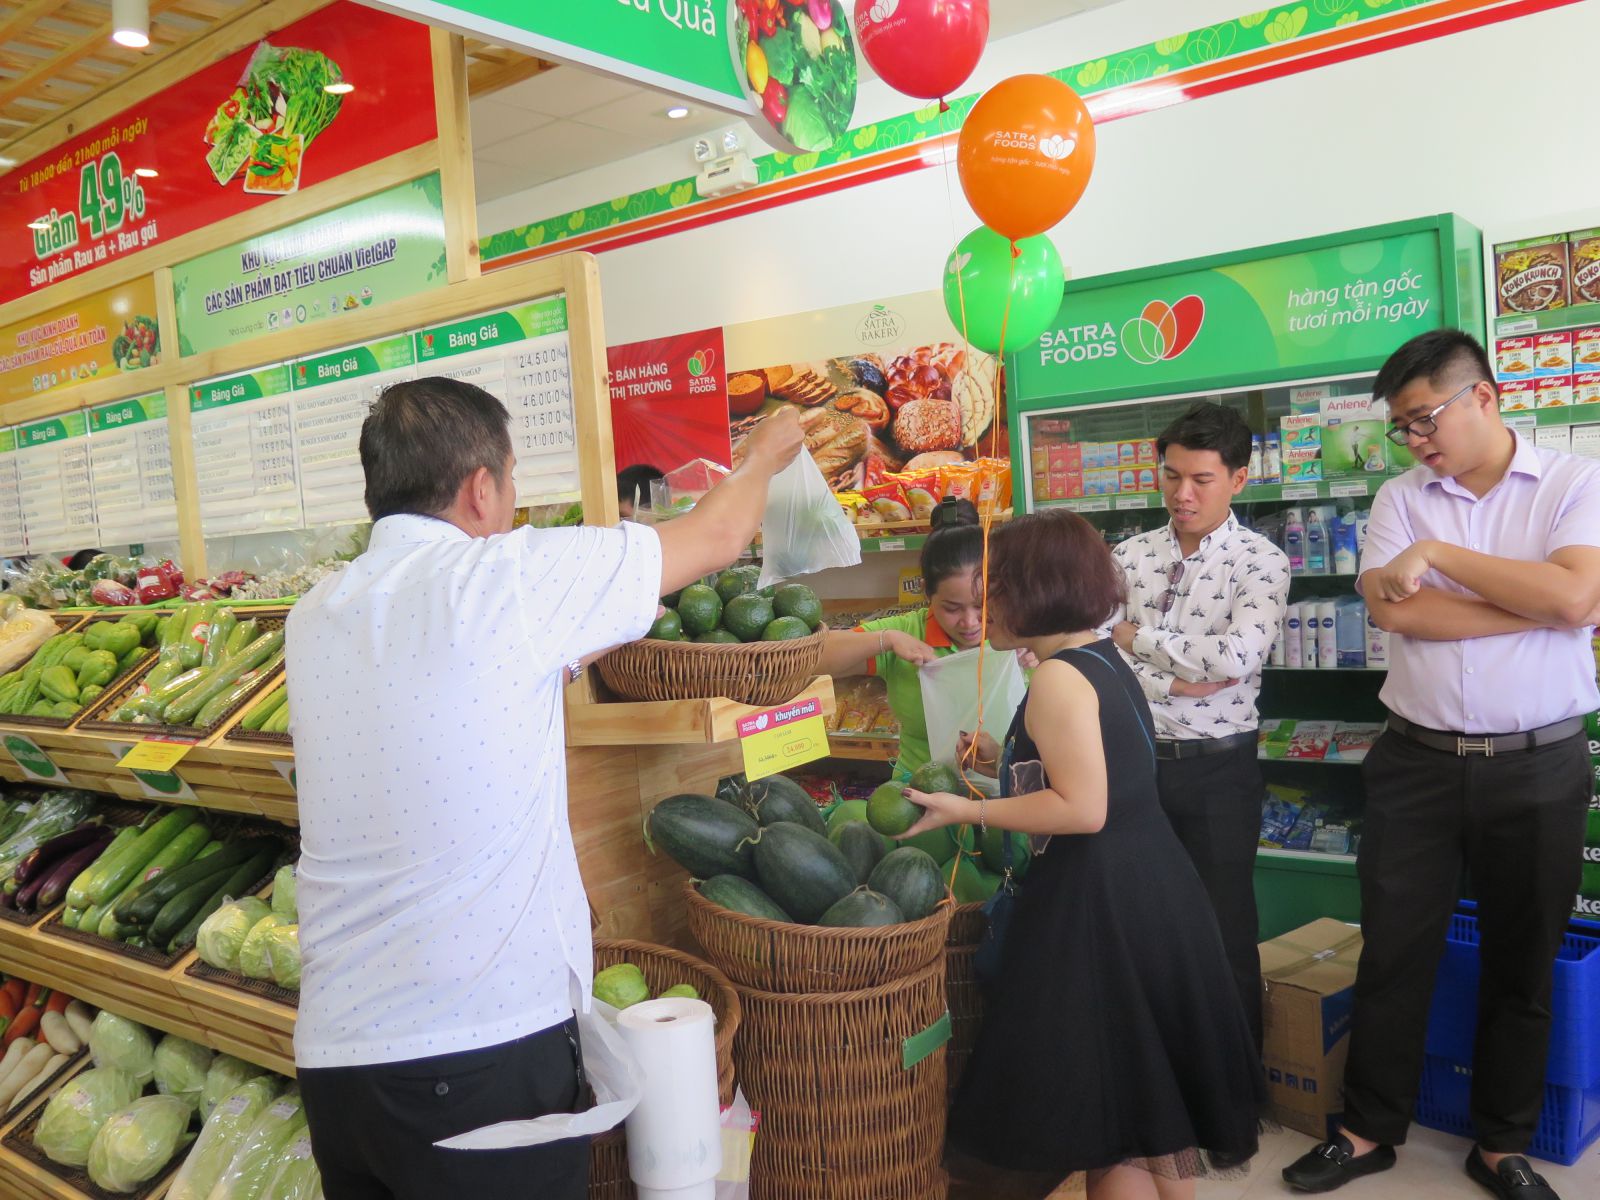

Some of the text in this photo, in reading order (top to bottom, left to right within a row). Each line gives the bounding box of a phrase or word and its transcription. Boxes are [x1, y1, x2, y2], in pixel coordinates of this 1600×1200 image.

[993, 139, 1037, 151] FOODS
[995, 130, 1037, 142] SATRA
[31, 164, 54, 187] 18h00
[56, 154, 72, 175] đến
[75, 140, 101, 166] 21h00
[102, 127, 120, 152] mỗi
[122, 117, 148, 142] ngày
[33, 150, 146, 261] Giảm 49%
[29, 265, 47, 287] Sản
[48, 253, 73, 283] phẩm
[74, 250, 93, 270] Rau
[118, 231, 139, 253] Rau
[140, 219, 158, 245] gói
[241, 252, 262, 274] KHU
[205, 237, 397, 315] CÁC SẢN PHẨM ĐẠT TIÊU CHUẨN VietGAP
[1503, 267, 1559, 295] KOKO KRUNCH
[1576, 265, 1599, 285] KOKO
[1287, 268, 1423, 307] hàng tận gốc
[864, 316, 896, 330] SATRA
[1289, 296, 1430, 332] tươi mỗi ngày
[448, 323, 499, 348] Bảng Giá
[861, 326, 899, 341] BAKERY
[1039, 322, 1117, 348] SATRA
[1539, 334, 1565, 344] Kellogg's
[1040, 341, 1118, 366] FOODS
[1501, 340, 1526, 349] Kellogg's
[317, 357, 358, 378] Bảng Giá
[616, 365, 637, 382] BÁN
[639, 363, 669, 380] HÀNG
[610, 379, 672, 401] THỊ TRƯỜNG
[688, 376, 716, 387] SATRA
[689, 384, 717, 394] FOODS
[1503, 382, 1528, 391] Kellogg's
[1540, 377, 1565, 387] Kellogg's
[211, 384, 245, 402] Bảng Giá
[1296, 390, 1322, 400] Anlene
[1327, 400, 1367, 411] Anlene
[105, 408, 133, 424] Bảng Giá
[1286, 416, 1313, 424] Anlene
[1288, 450, 1314, 458] Anlene
[774, 705, 801, 723] khuyến
